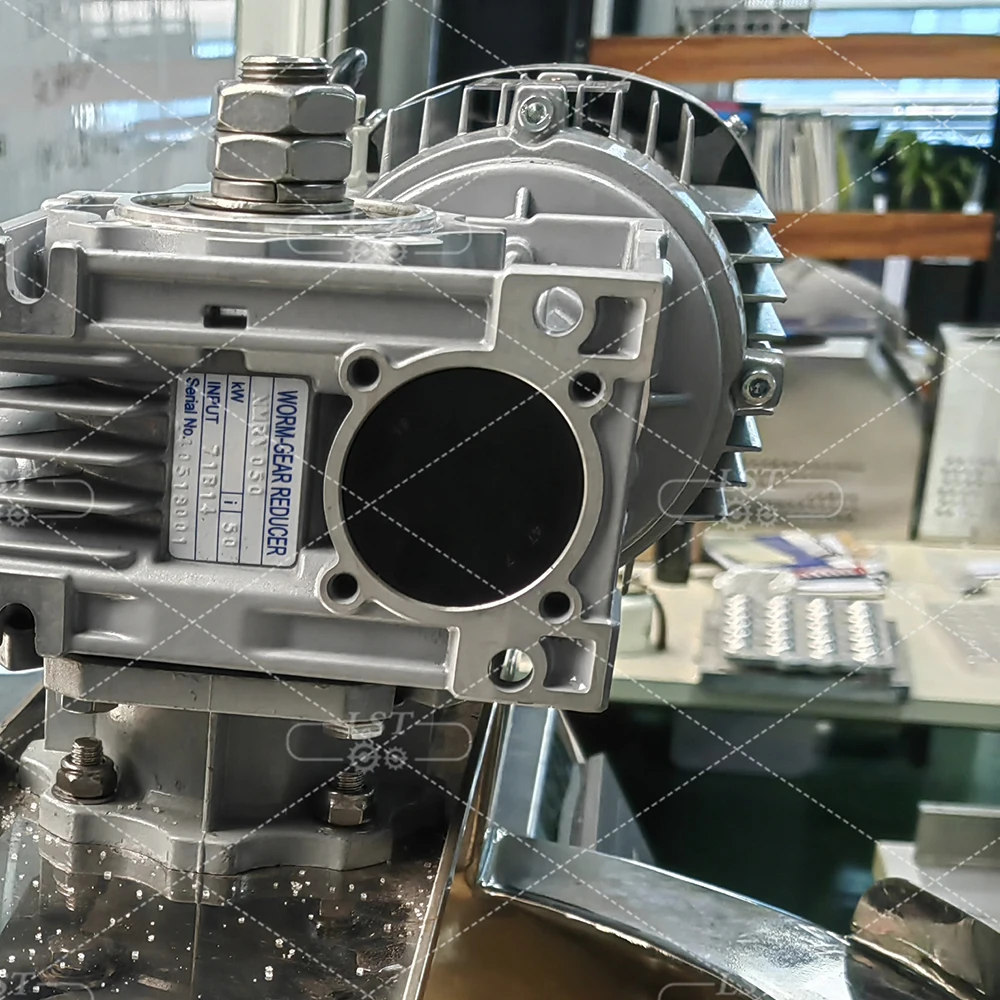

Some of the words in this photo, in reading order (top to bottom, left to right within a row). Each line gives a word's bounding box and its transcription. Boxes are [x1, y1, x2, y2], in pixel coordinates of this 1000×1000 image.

[184, 376, 200, 414] Serial
[204, 380, 221, 425] INPUT
[230, 381, 245, 403] kW
[181, 418, 197, 440] No.
[271, 390, 299, 483] WORM-GEAR
[266, 487, 291, 557] REDUCER
